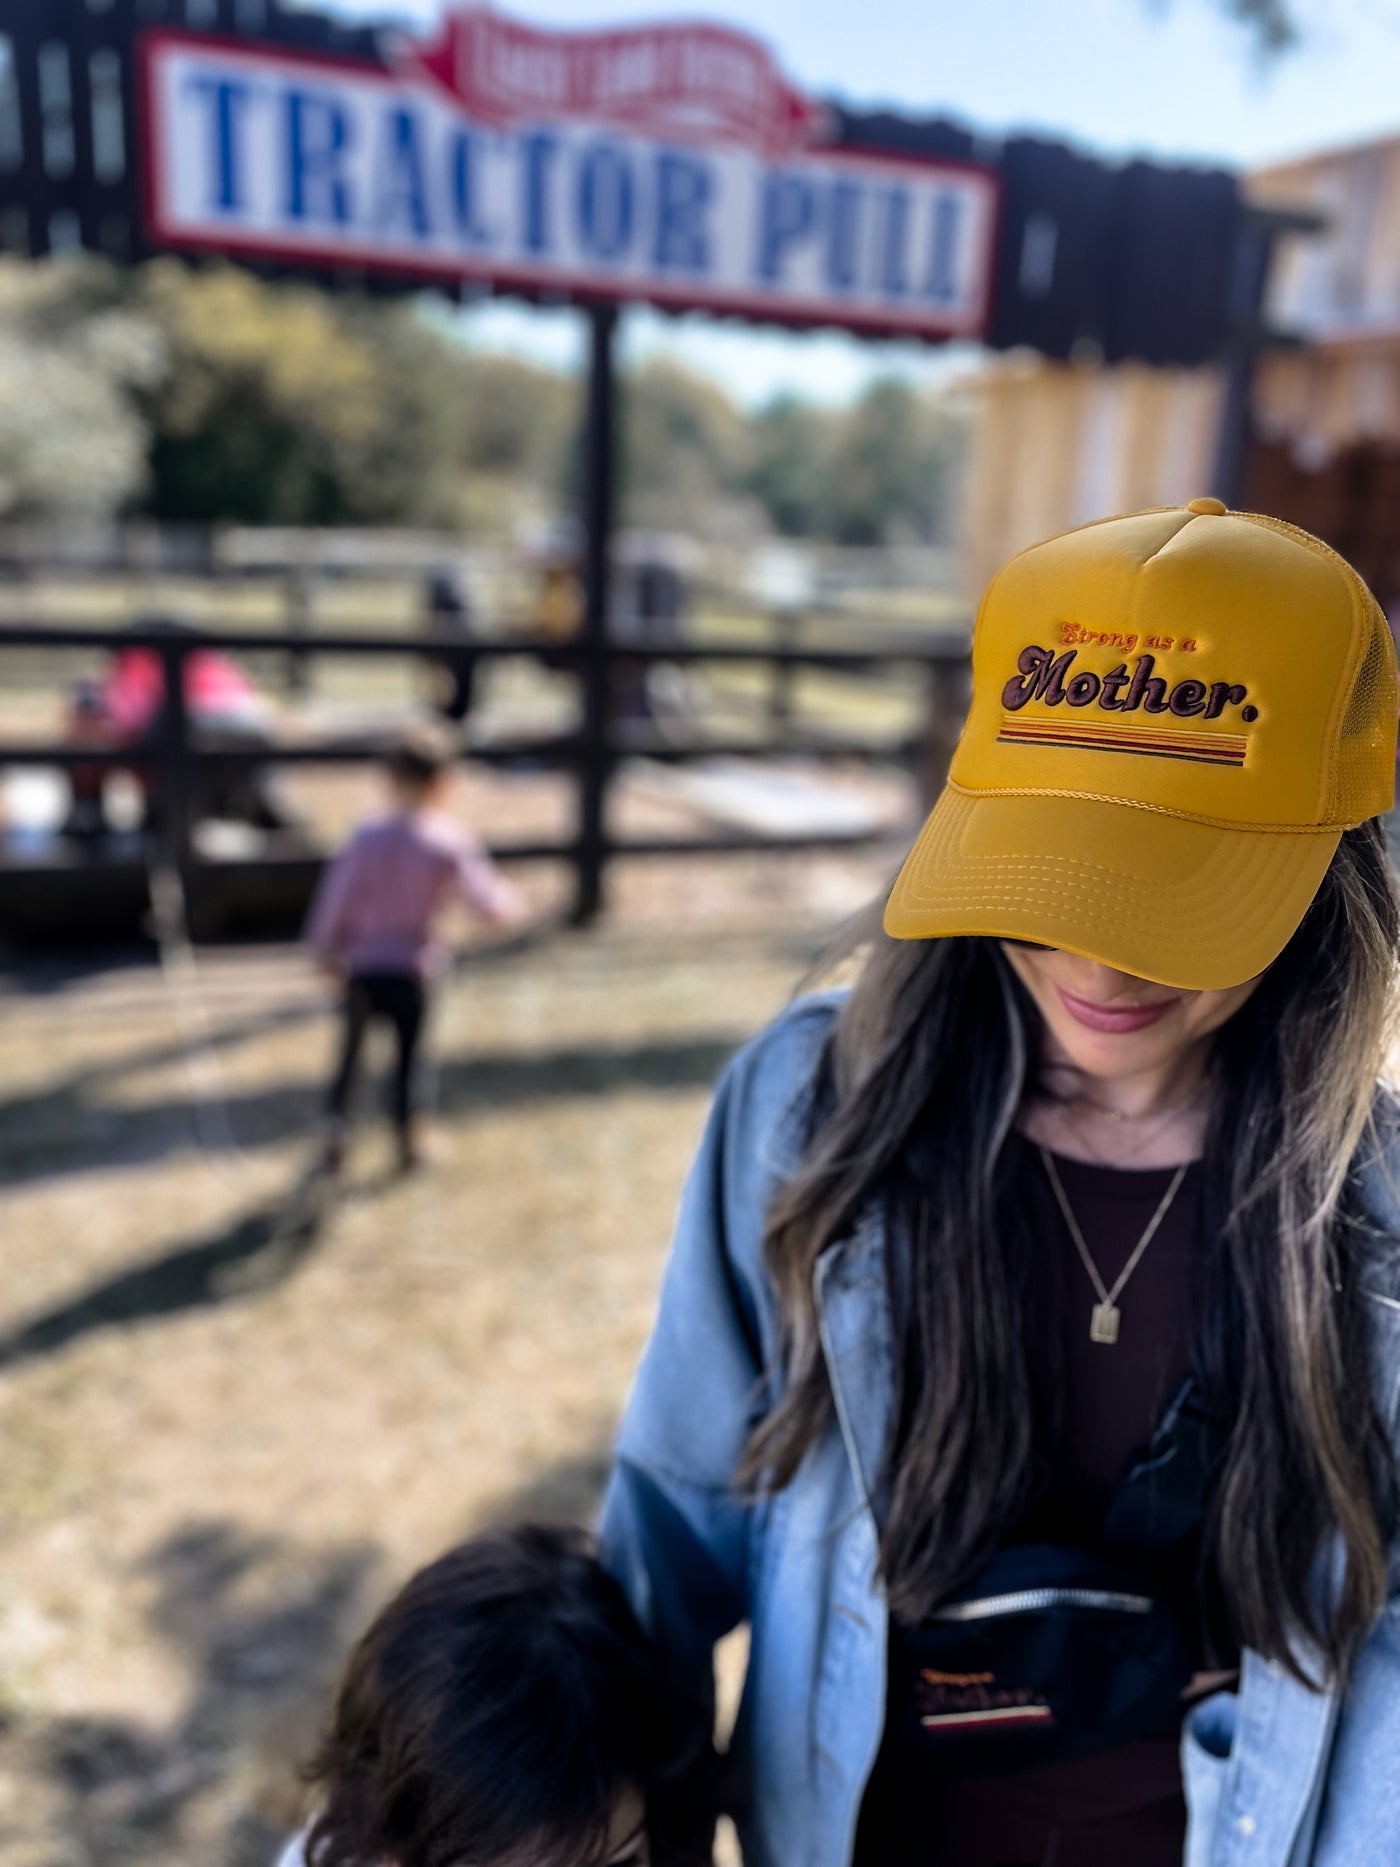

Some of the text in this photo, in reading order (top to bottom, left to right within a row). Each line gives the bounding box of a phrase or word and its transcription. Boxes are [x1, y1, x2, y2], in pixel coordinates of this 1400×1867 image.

[184, 74, 712, 274] TRACTOR
[1060, 621, 1197, 654] Strong as a
[1001, 645, 1259, 723] Mother.
